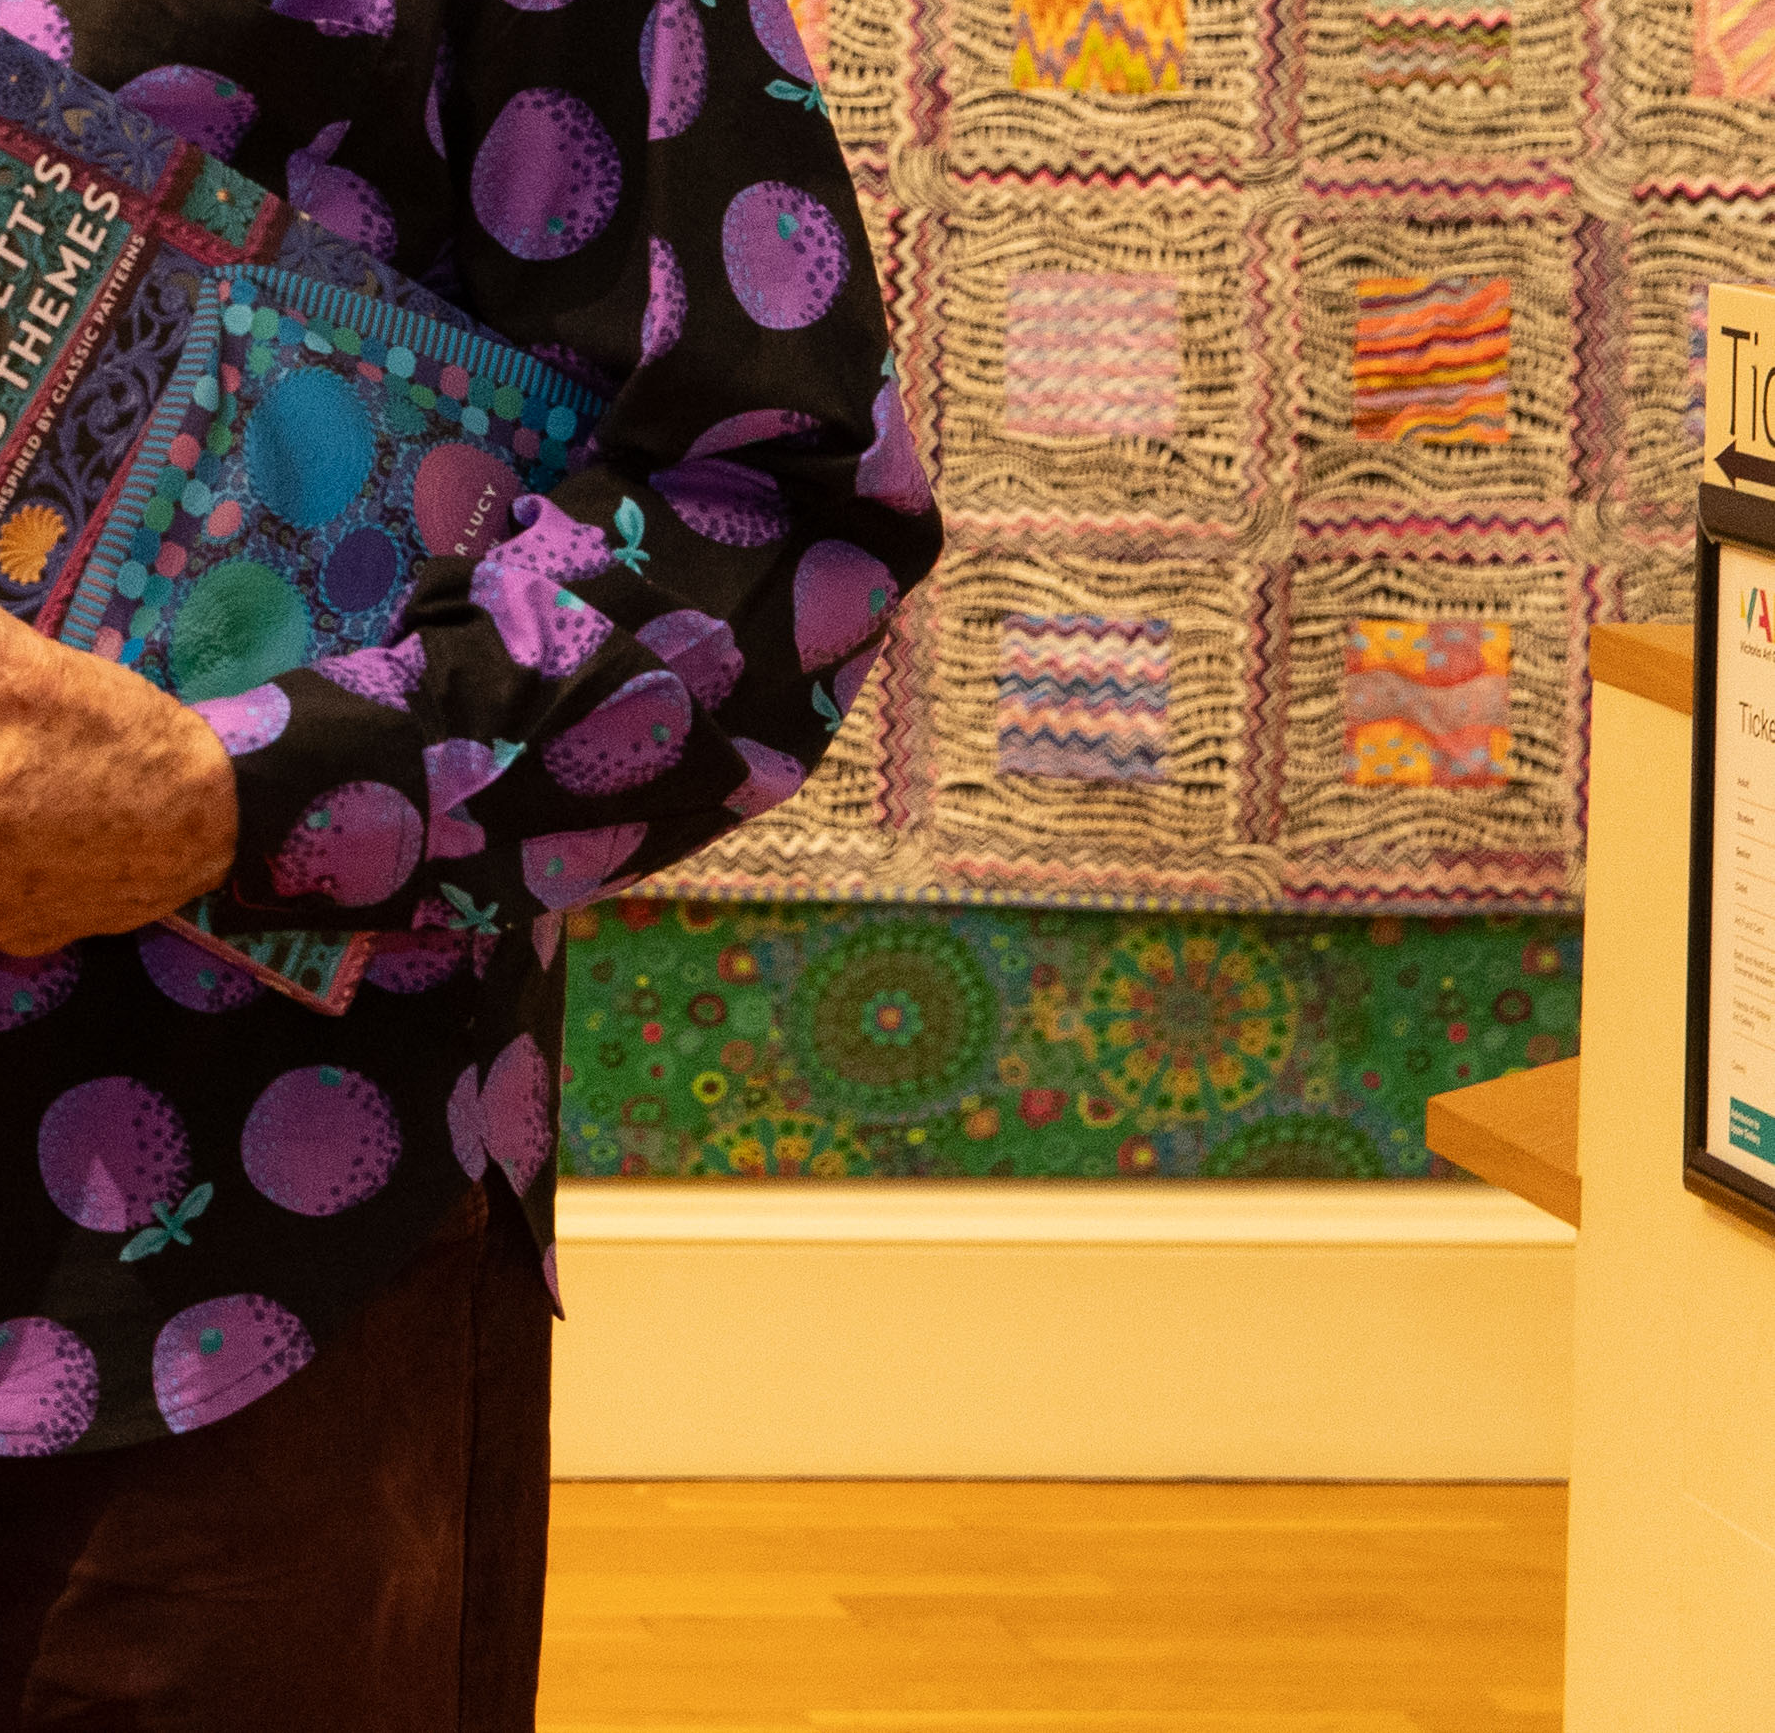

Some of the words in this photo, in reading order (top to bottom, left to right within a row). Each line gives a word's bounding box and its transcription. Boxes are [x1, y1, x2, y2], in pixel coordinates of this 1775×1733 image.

[35, 406, 56, 434] BY
[52, 326, 99, 406] CLASSIC
[94, 232, 147, 332] PATTERNS
[464, 483, 497, 537] LUCY
